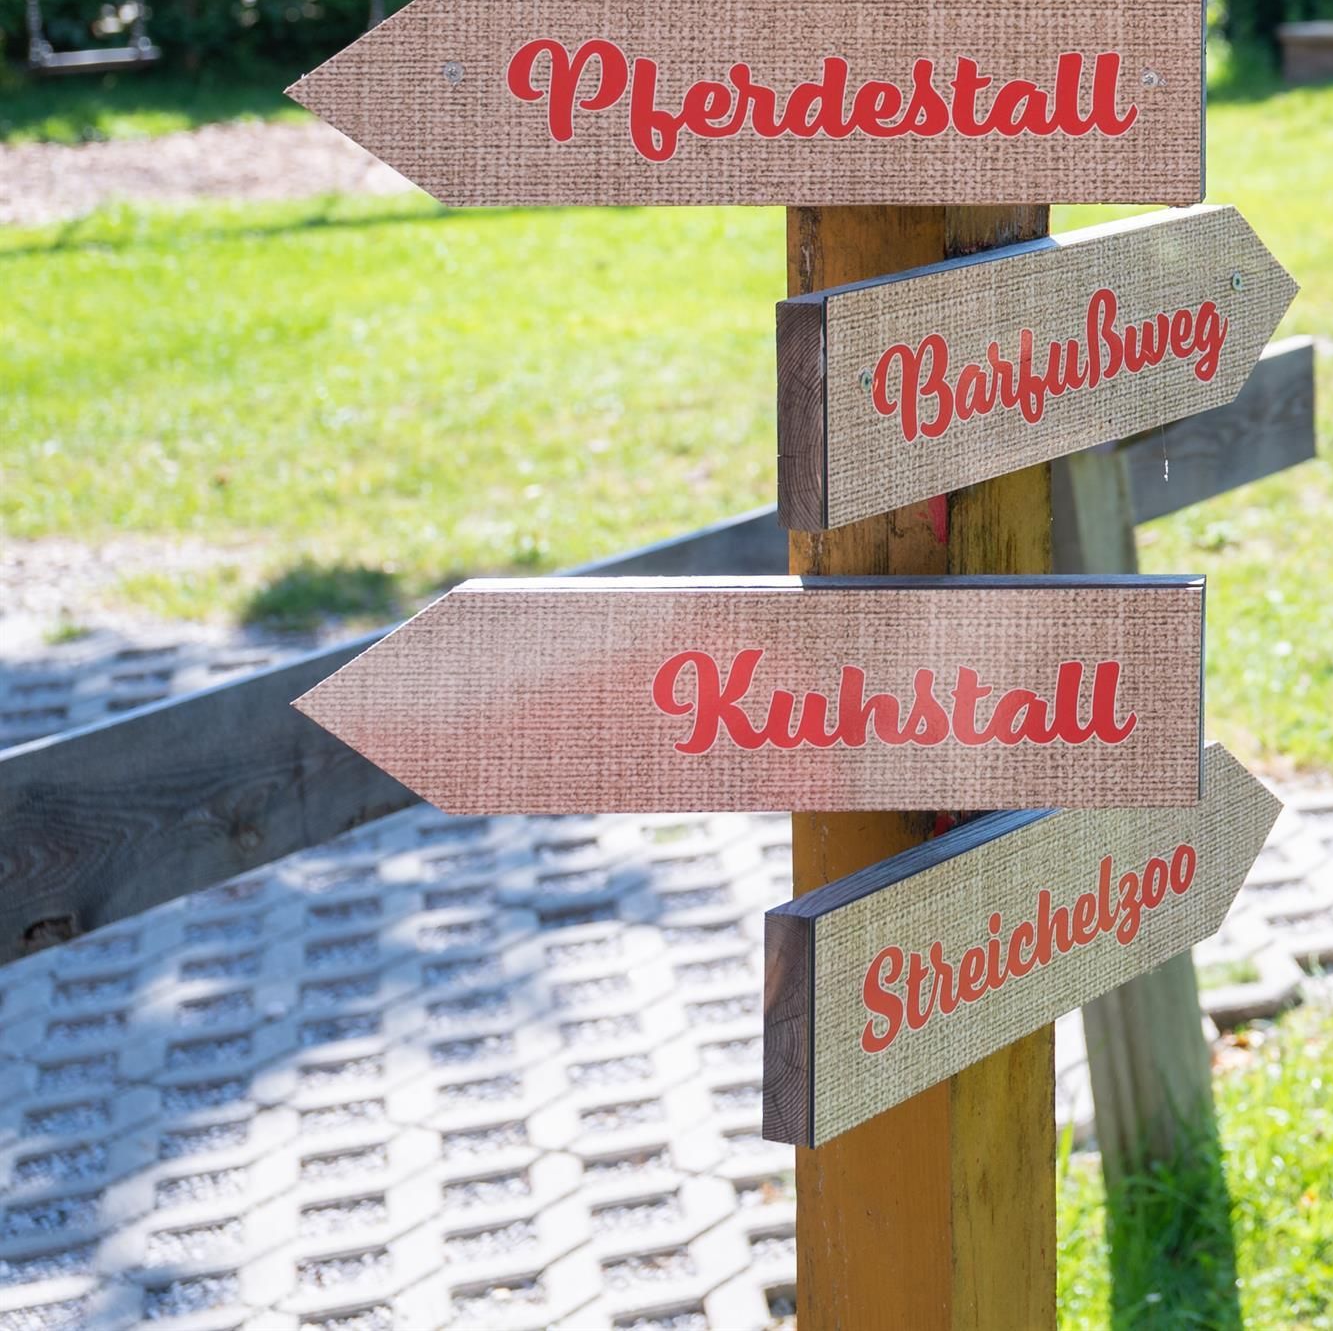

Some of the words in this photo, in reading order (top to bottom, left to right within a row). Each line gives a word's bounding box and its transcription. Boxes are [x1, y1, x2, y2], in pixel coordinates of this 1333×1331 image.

[506, 37, 1138, 162] Pferdestall
[872, 287, 1228, 442] Barfußweg
[652, 648, 1138, 755] Kuhstall
[860, 842, 1198, 1054] Streichelzoo
